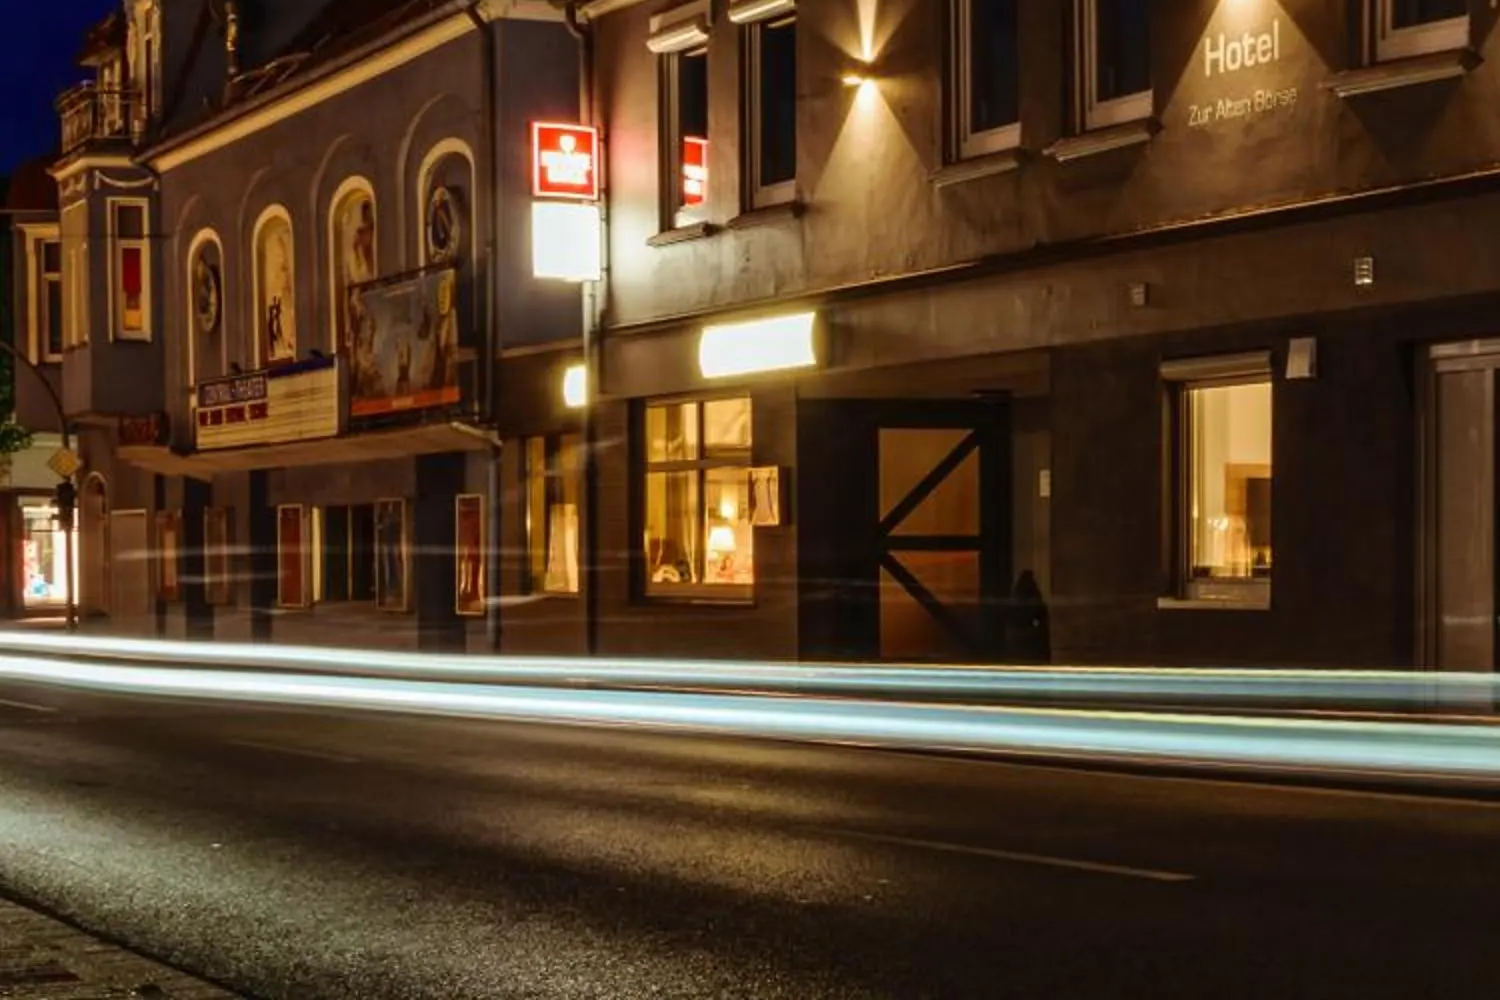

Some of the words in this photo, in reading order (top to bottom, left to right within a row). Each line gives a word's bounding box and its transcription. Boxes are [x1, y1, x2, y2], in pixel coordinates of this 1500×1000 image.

[1203, 18, 1279, 77] Hotel
[1187, 104, 1213, 127] Zur
[1215, 97, 1252, 120] Alten
